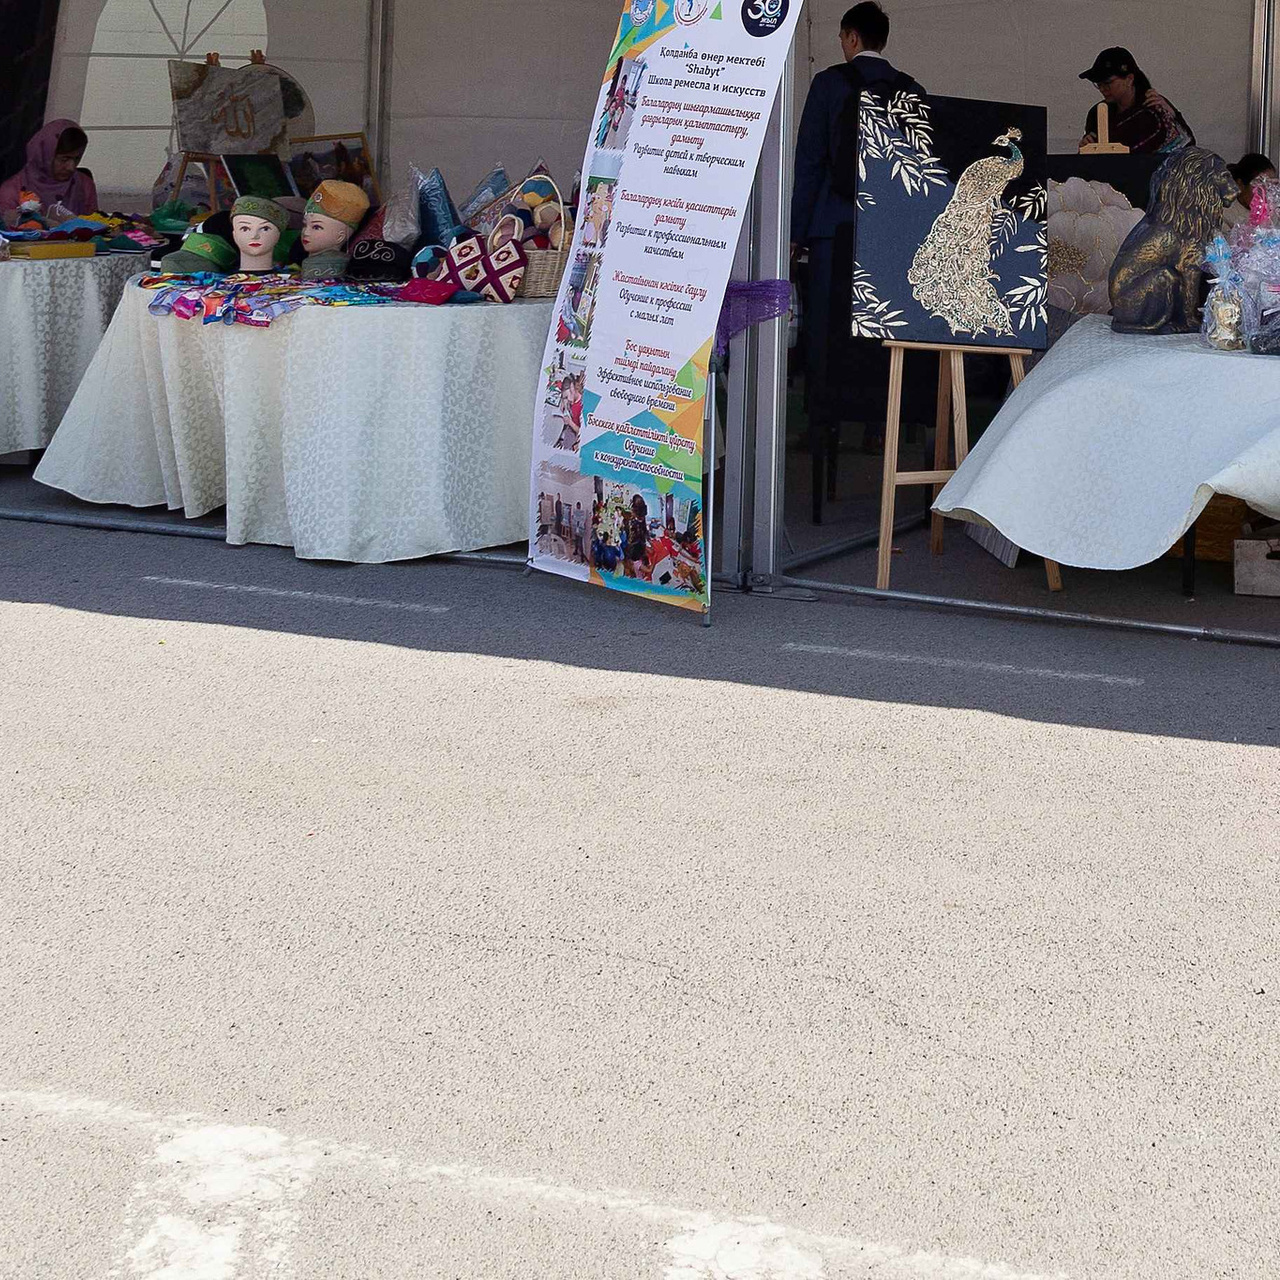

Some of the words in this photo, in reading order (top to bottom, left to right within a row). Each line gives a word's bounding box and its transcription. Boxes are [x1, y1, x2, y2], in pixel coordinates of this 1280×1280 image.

[660, 46, 698, 59] Қолданба
[701, 52, 724, 64] өнер
[726, 57, 766, 67] мектебі
[648, 74, 672, 86] Школа
[673, 79, 710, 90] ремесла
[713, 83, 719, 91] и
[722, 85, 766, 97] искусств
[670, 133, 704, 150] дамыту
[633, 143, 664, 158] Развитие
[664, 149, 688, 162] детей
[689, 152, 695, 160] к
[695, 152, 745, 168] творческим
[663, 164, 698, 177] навыкам
[654, 214, 687, 230] дамыту
[615, 221, 647, 238] Развитие
[648, 228, 653, 237] к
[653, 230, 727, 250] профессиональным
[643, 245, 684, 259] качествам
[619, 288, 649, 305] Обучение
[649, 296, 654, 305] к
[655, 297, 693, 312] профессии
[635, 310, 659, 323] малых
[659, 316, 674, 325] лет
[597, 366, 643, 388] Эффективное
[644, 380, 692, 398] использование
[609, 387, 646, 405] свободного
[646, 395, 676, 411] времени
[624, 439, 656, 457] Обучение
